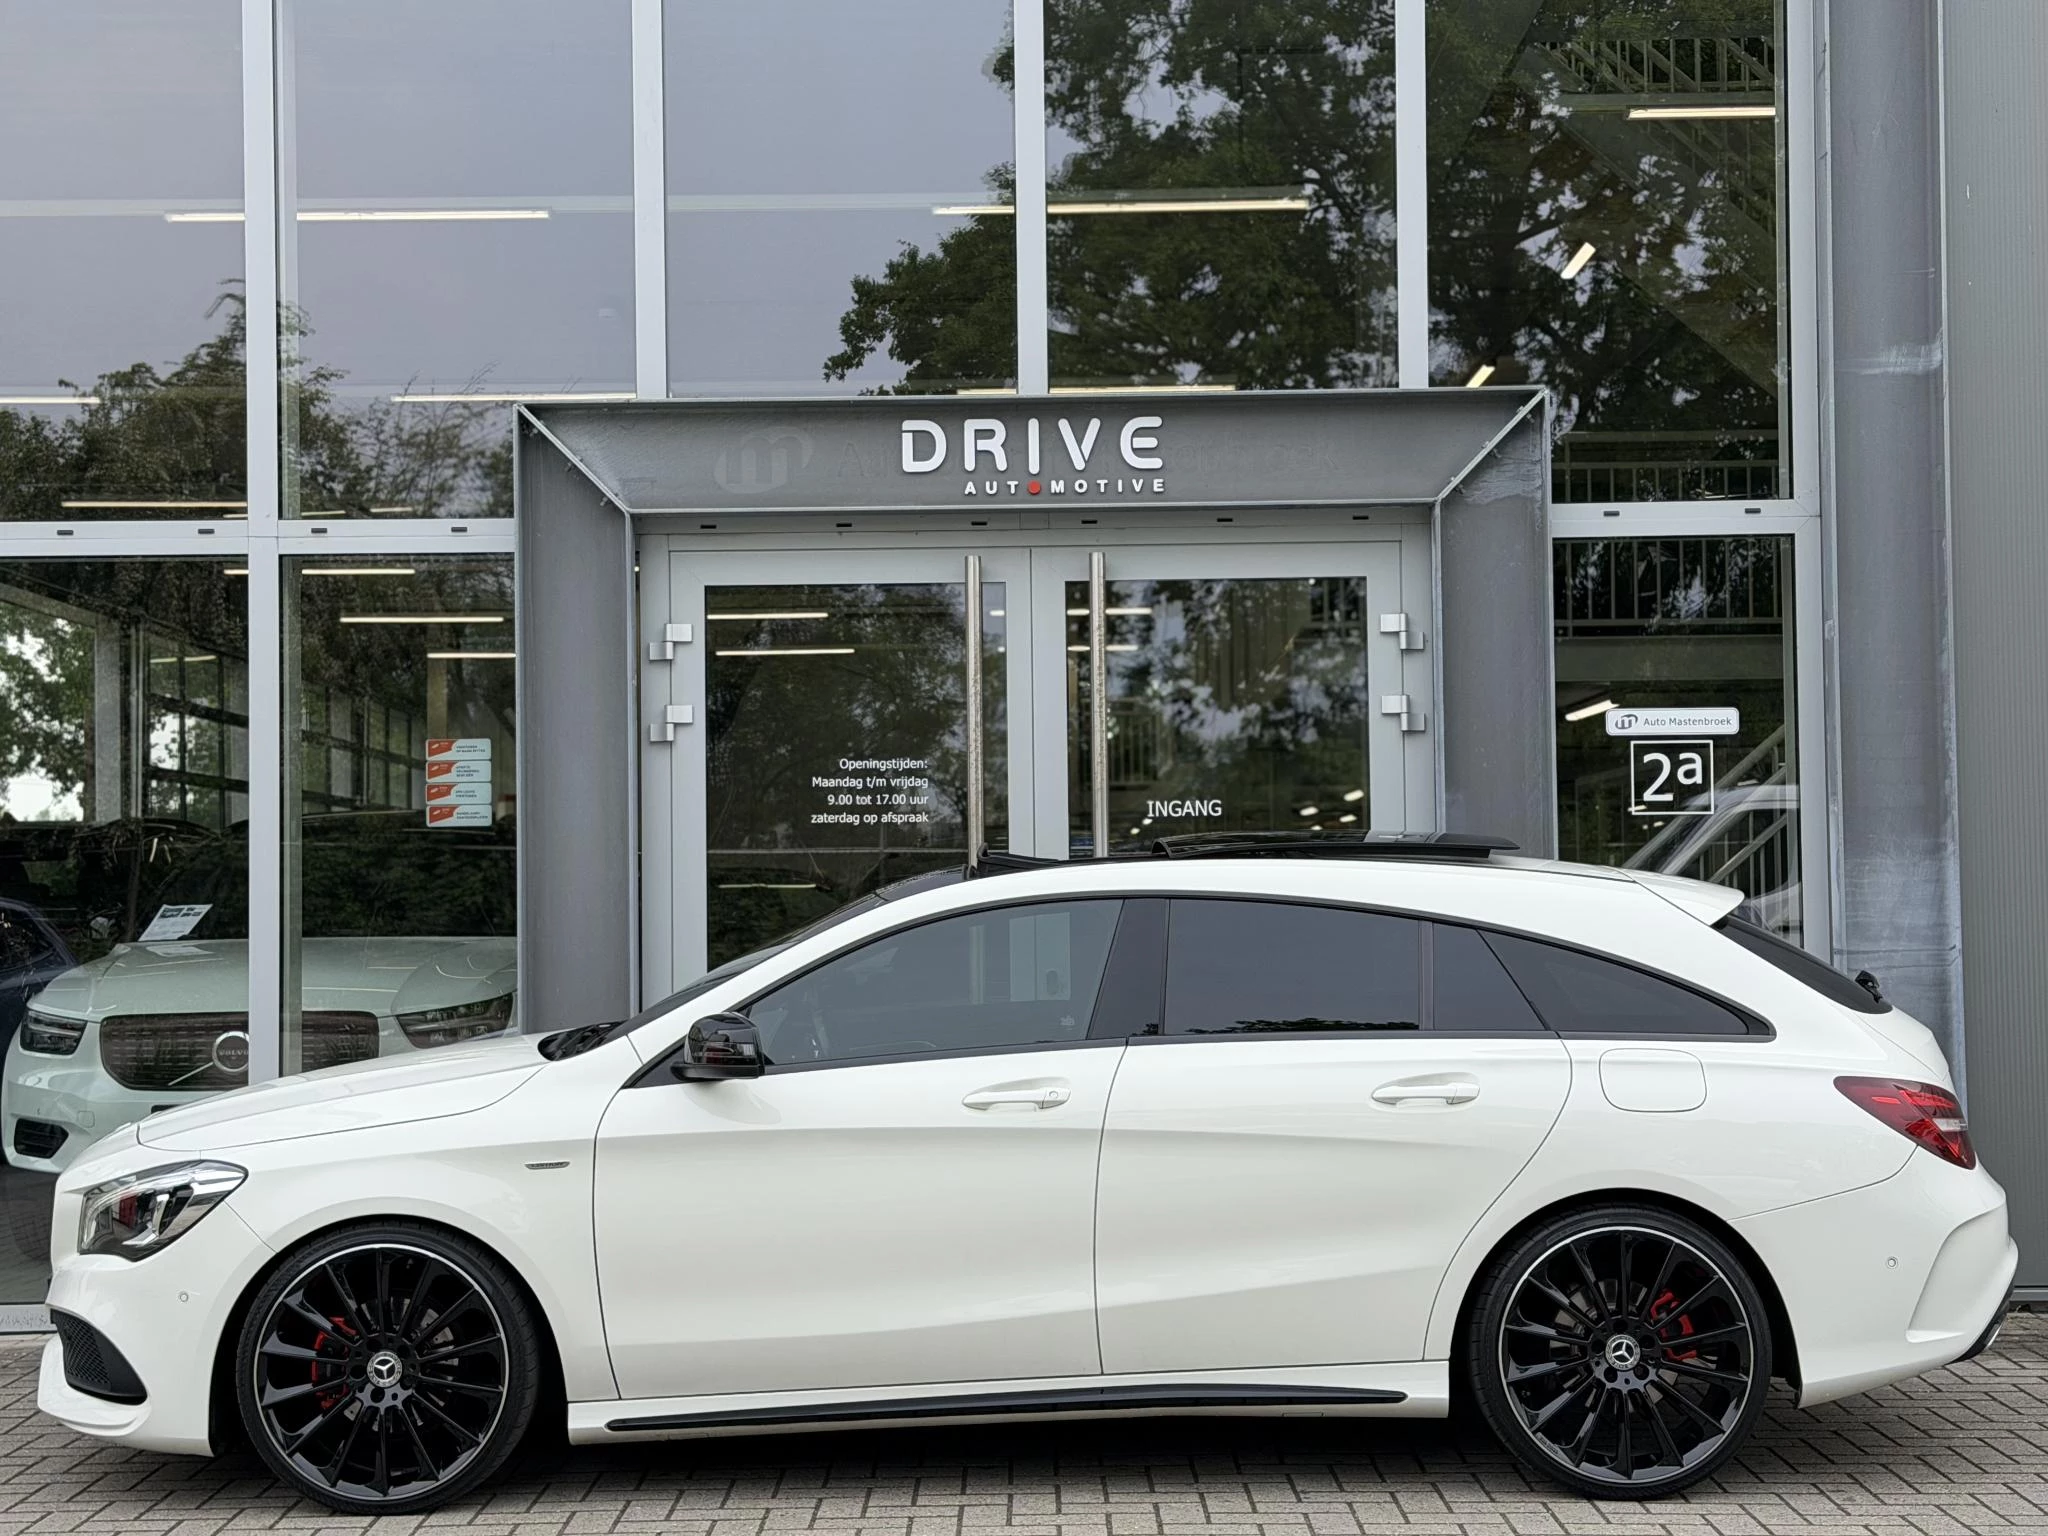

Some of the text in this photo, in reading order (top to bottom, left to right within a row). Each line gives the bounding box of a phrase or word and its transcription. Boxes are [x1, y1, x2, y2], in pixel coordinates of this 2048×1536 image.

[901, 416, 1163, 475] DRIVE
[1643, 717, 1666, 726] Auto
[1669, 716, 1732, 726] Mastenbroek
[839, 757, 928, 771] Openingstijden:
[812, 775, 929, 789] Maandag t/m vrijdag
[1642, 752, 1703, 802] 2a
[827, 794, 929, 805] 9.00 tot 17.00 uur
[1146, 799, 1222, 817] INGANG
[810, 812, 929, 825] zaterdag op afspraak
